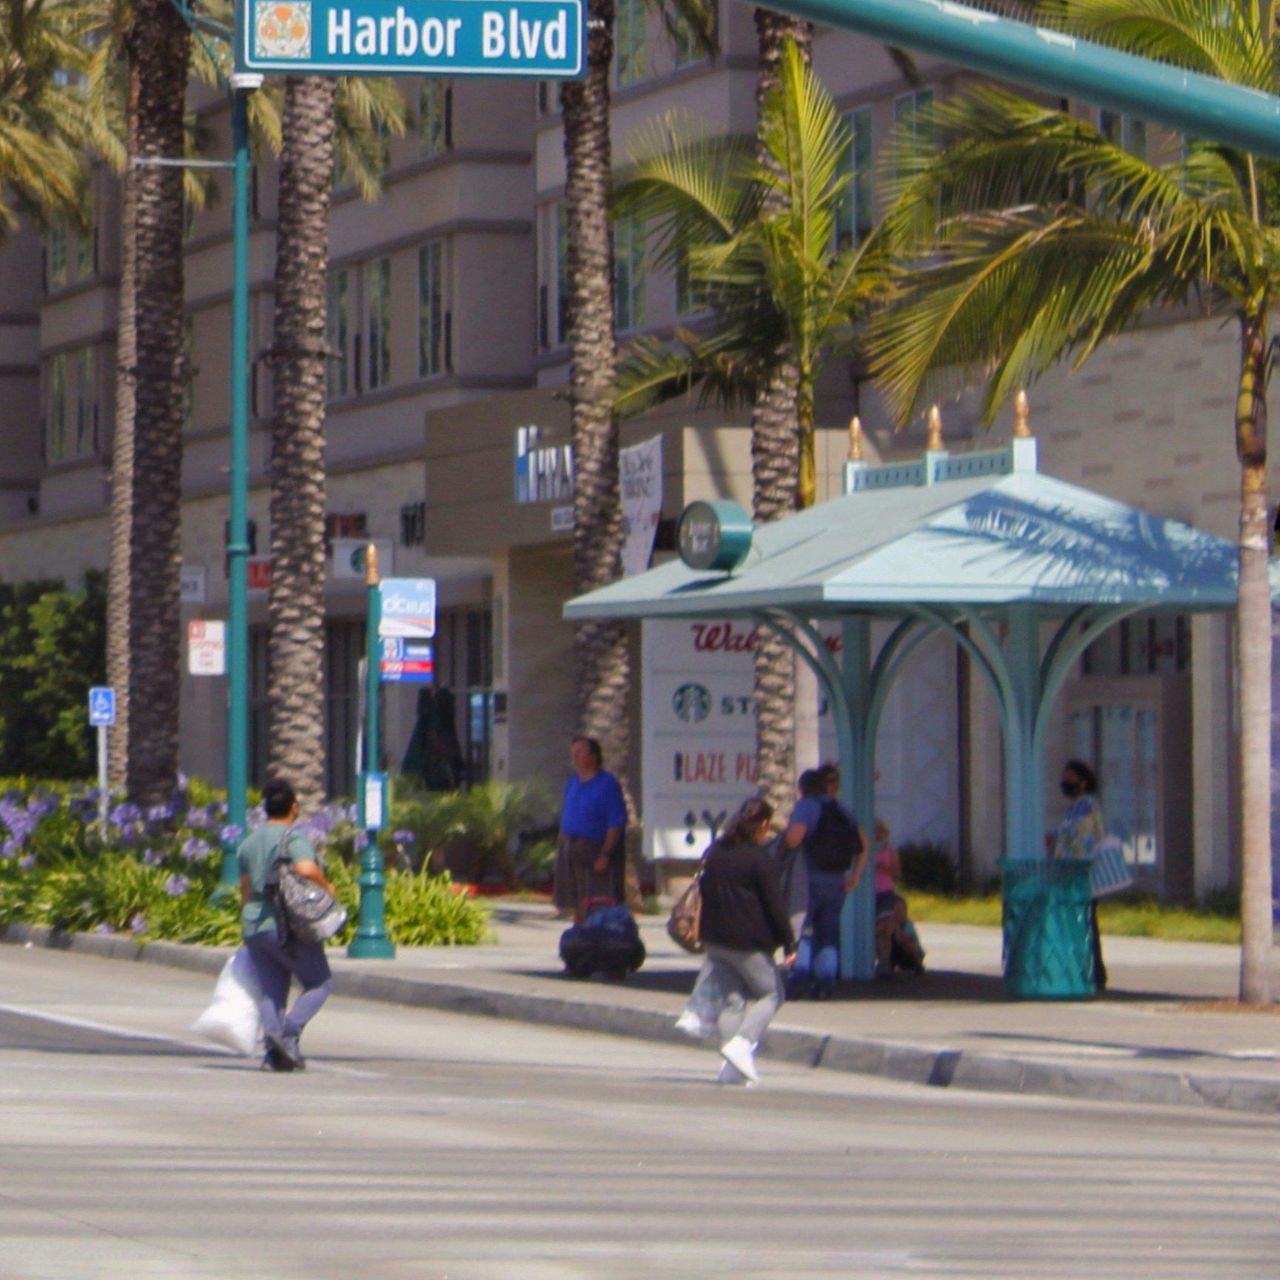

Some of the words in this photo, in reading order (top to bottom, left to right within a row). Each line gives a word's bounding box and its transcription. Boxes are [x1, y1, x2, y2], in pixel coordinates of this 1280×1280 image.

[327, 6, 462, 57] Harbor
[482, 8, 567, 60] Blvd
[673, 752, 727, 784] BLAZE
